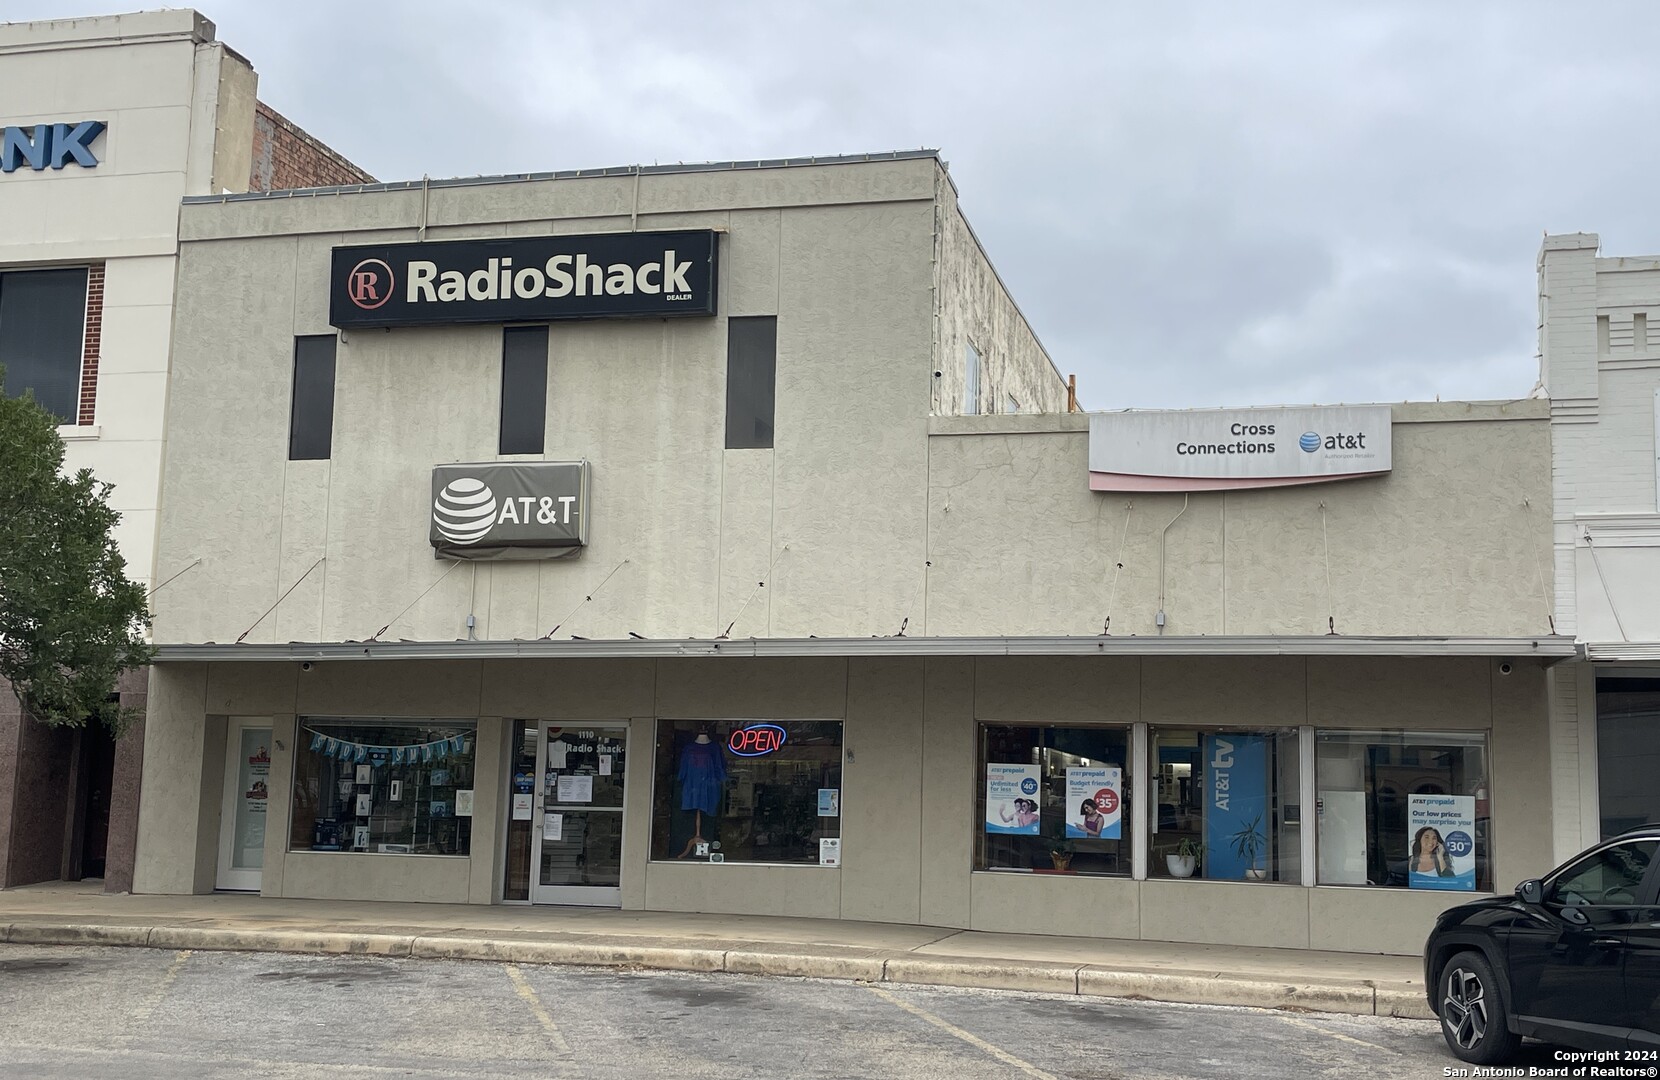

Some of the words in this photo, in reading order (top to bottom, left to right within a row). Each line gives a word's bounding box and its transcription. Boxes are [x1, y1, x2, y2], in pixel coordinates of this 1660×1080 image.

[0, 120, 104, 172] NK
[406, 250, 693, 303] RadioShack
[666, 293, 692, 301] DEALER
[1230, 423, 1275, 436] Cross
[1177, 440, 1276, 455] Connections
[1324, 432, 1366, 450] at&t
[497, 496, 576, 525] AT&T
[578, 730, 595, 739] 1110
[730, 730, 782, 751] OPEN
[566, 743, 594, 753] Radio
[1211, 737, 1234, 769] tv
[1216, 770, 1230, 812] AT&T
[1426, 798, 1455, 806] prepaid
[1428, 818, 1457, 826] surprise
[1457, 819, 1472, 827] you
